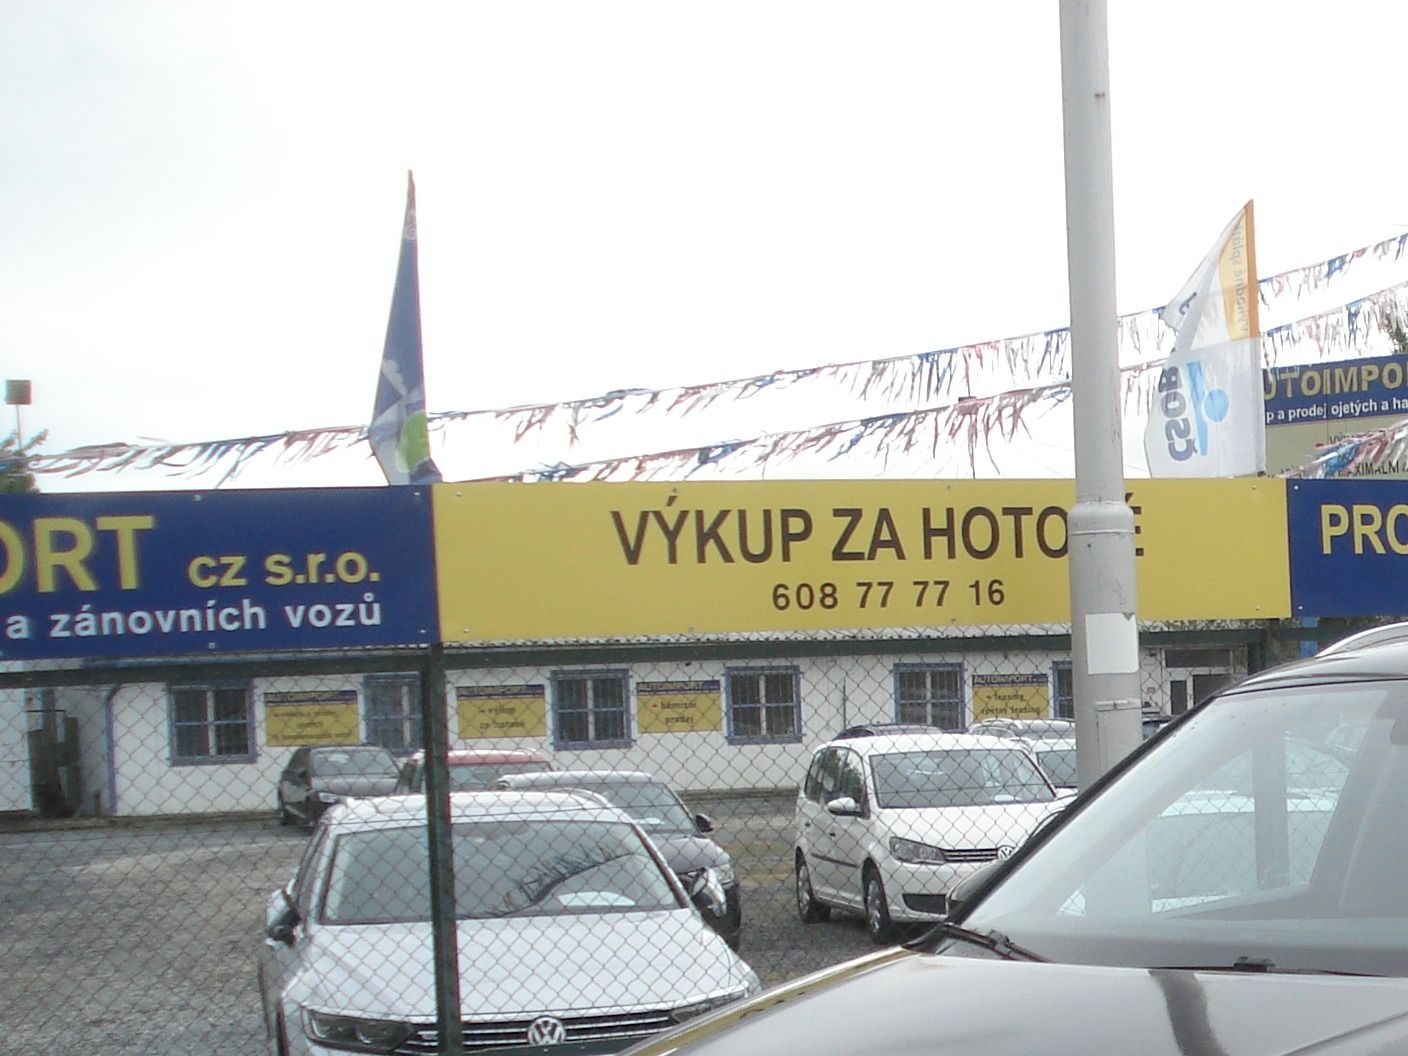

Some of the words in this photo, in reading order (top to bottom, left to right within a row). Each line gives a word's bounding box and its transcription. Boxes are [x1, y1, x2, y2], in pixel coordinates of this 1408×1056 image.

[1277, 410, 1285, 420] a
[1288, 402, 1327, 422] prodej
[1331, 399, 1377, 416] ojetých
[1380, 400, 1389, 411] a
[611, 494, 813, 566] VÝKUP
[831, 507, 906, 562] ZA
[922, 492, 1144, 560] HOTO
[188, 556, 247, 588] cz
[264, 551, 381, 587] s.r.o.
[772, 582, 839, 611] 608
[856, 581, 894, 609] 77
[913, 580, 950, 607] 77
[969, 579, 1006, 606] 16
[6, 614, 32, 640] a
[50, 599, 267, 638] zánovních
[284, 592, 382, 628] vozů
